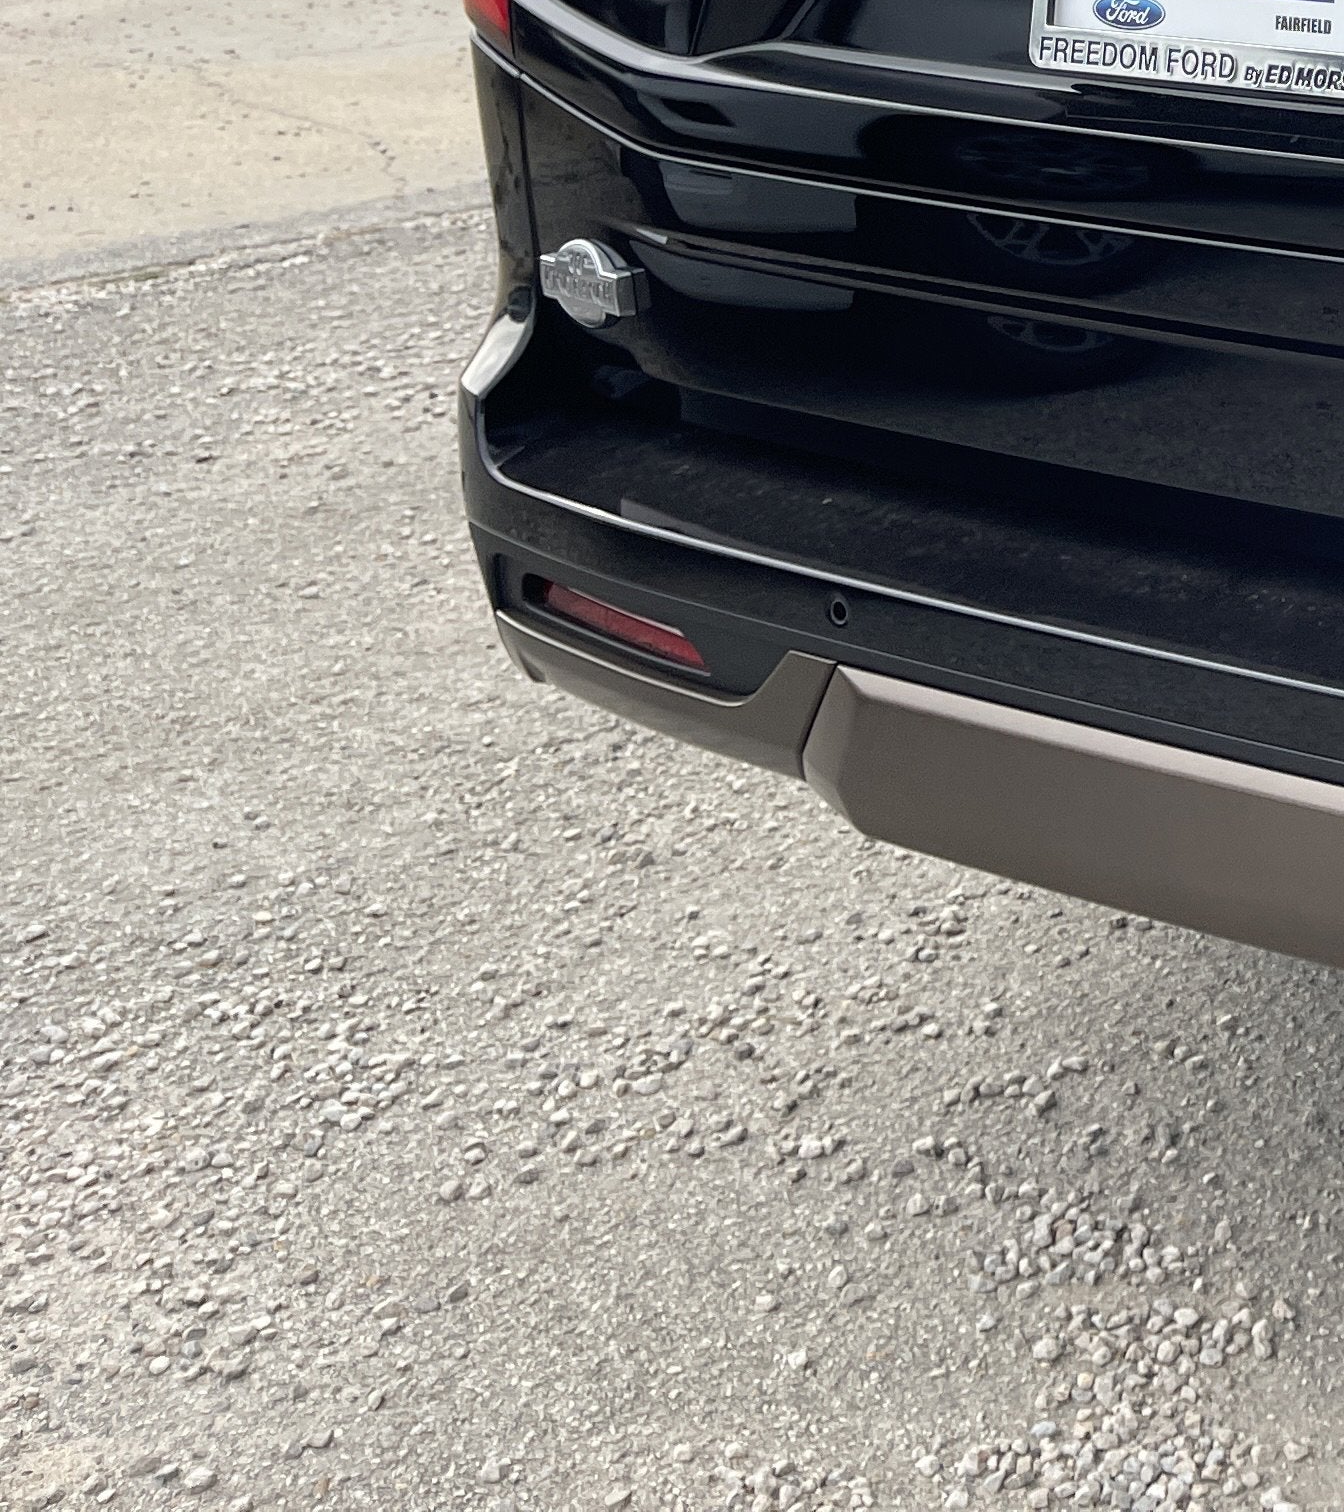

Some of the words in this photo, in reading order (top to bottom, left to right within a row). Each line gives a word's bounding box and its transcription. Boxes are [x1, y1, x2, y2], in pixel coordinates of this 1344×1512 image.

[1275, 15, 1332, 35] FAIRFIELD
[1039, 36, 1159, 73] FREEDOM
[1165, 47, 1236, 81] FORD
[1264, 64, 1293, 86] ED
